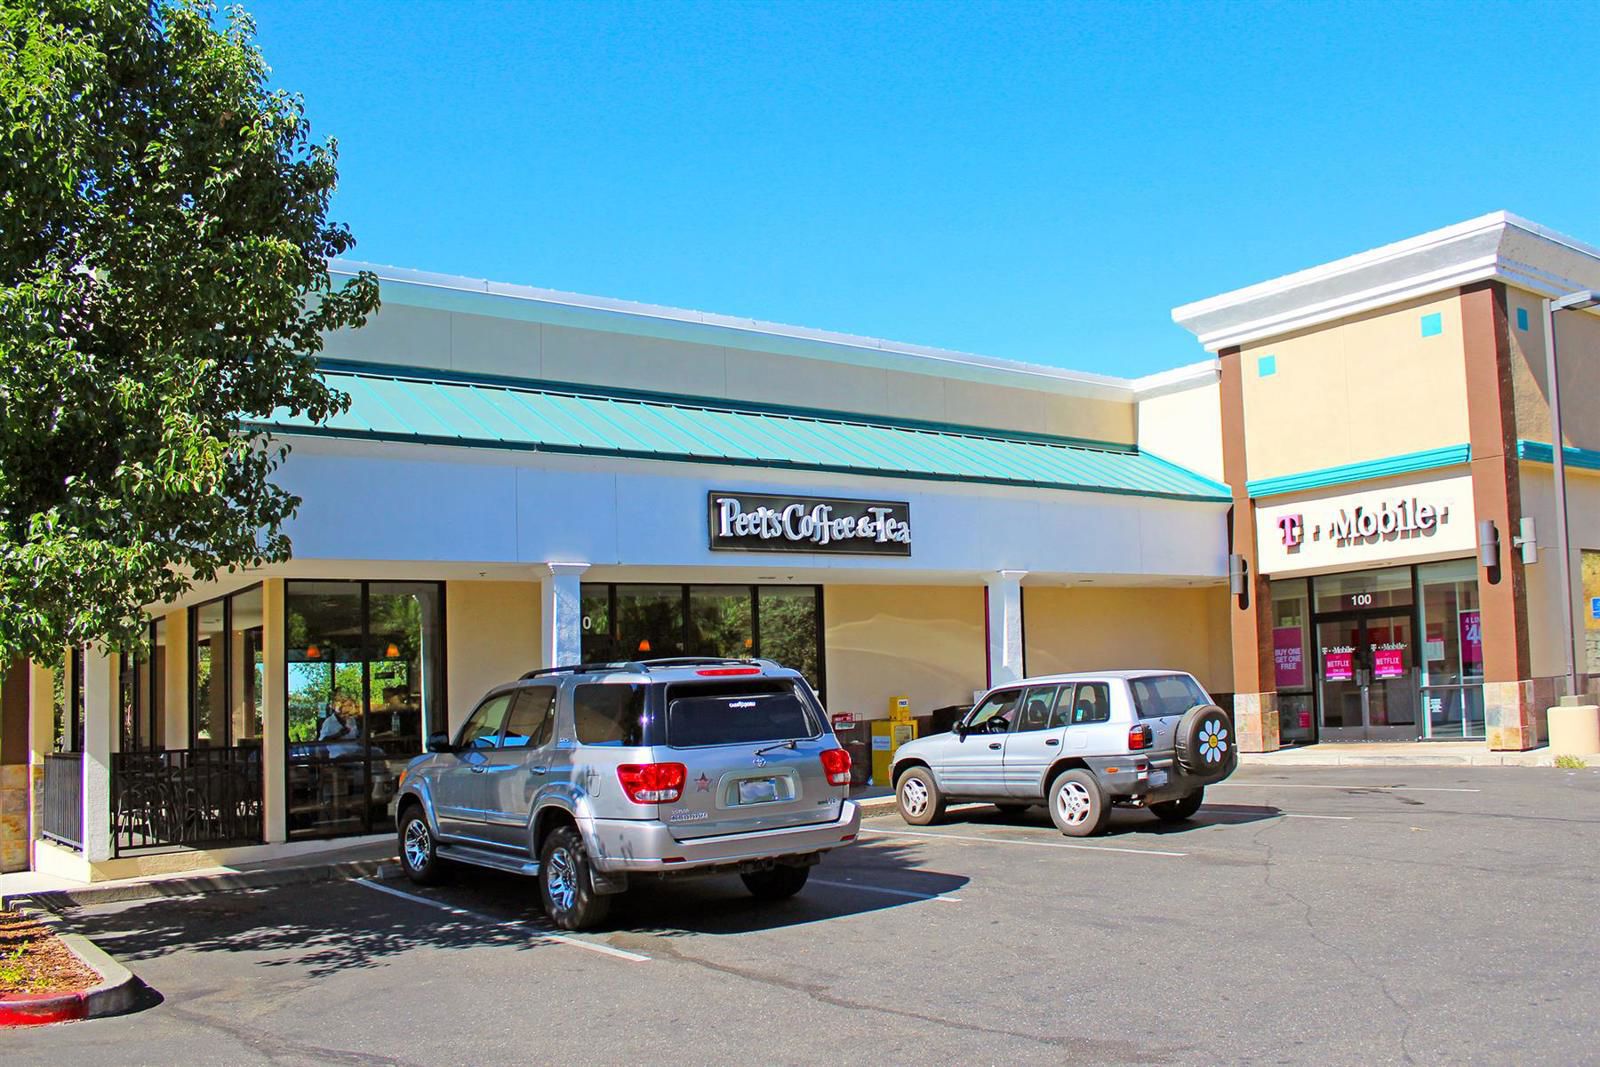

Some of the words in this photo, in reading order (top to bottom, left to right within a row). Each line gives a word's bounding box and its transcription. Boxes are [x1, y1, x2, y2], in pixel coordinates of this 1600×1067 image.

[781, 503, 855, 545] Coffee
[855, 515, 876, 537] &
[868, 507, 911, 544] Tea
[1352, 594, 1372, 605] 100
[1275, 648, 1287, 656] BUY
[1288, 647, 1301, 655] ONE
[1327, 660, 1350, 668] NETFLIX
[1375, 657, 1400, 665] NETFLIX
[1280, 662, 1296, 670] FREE
